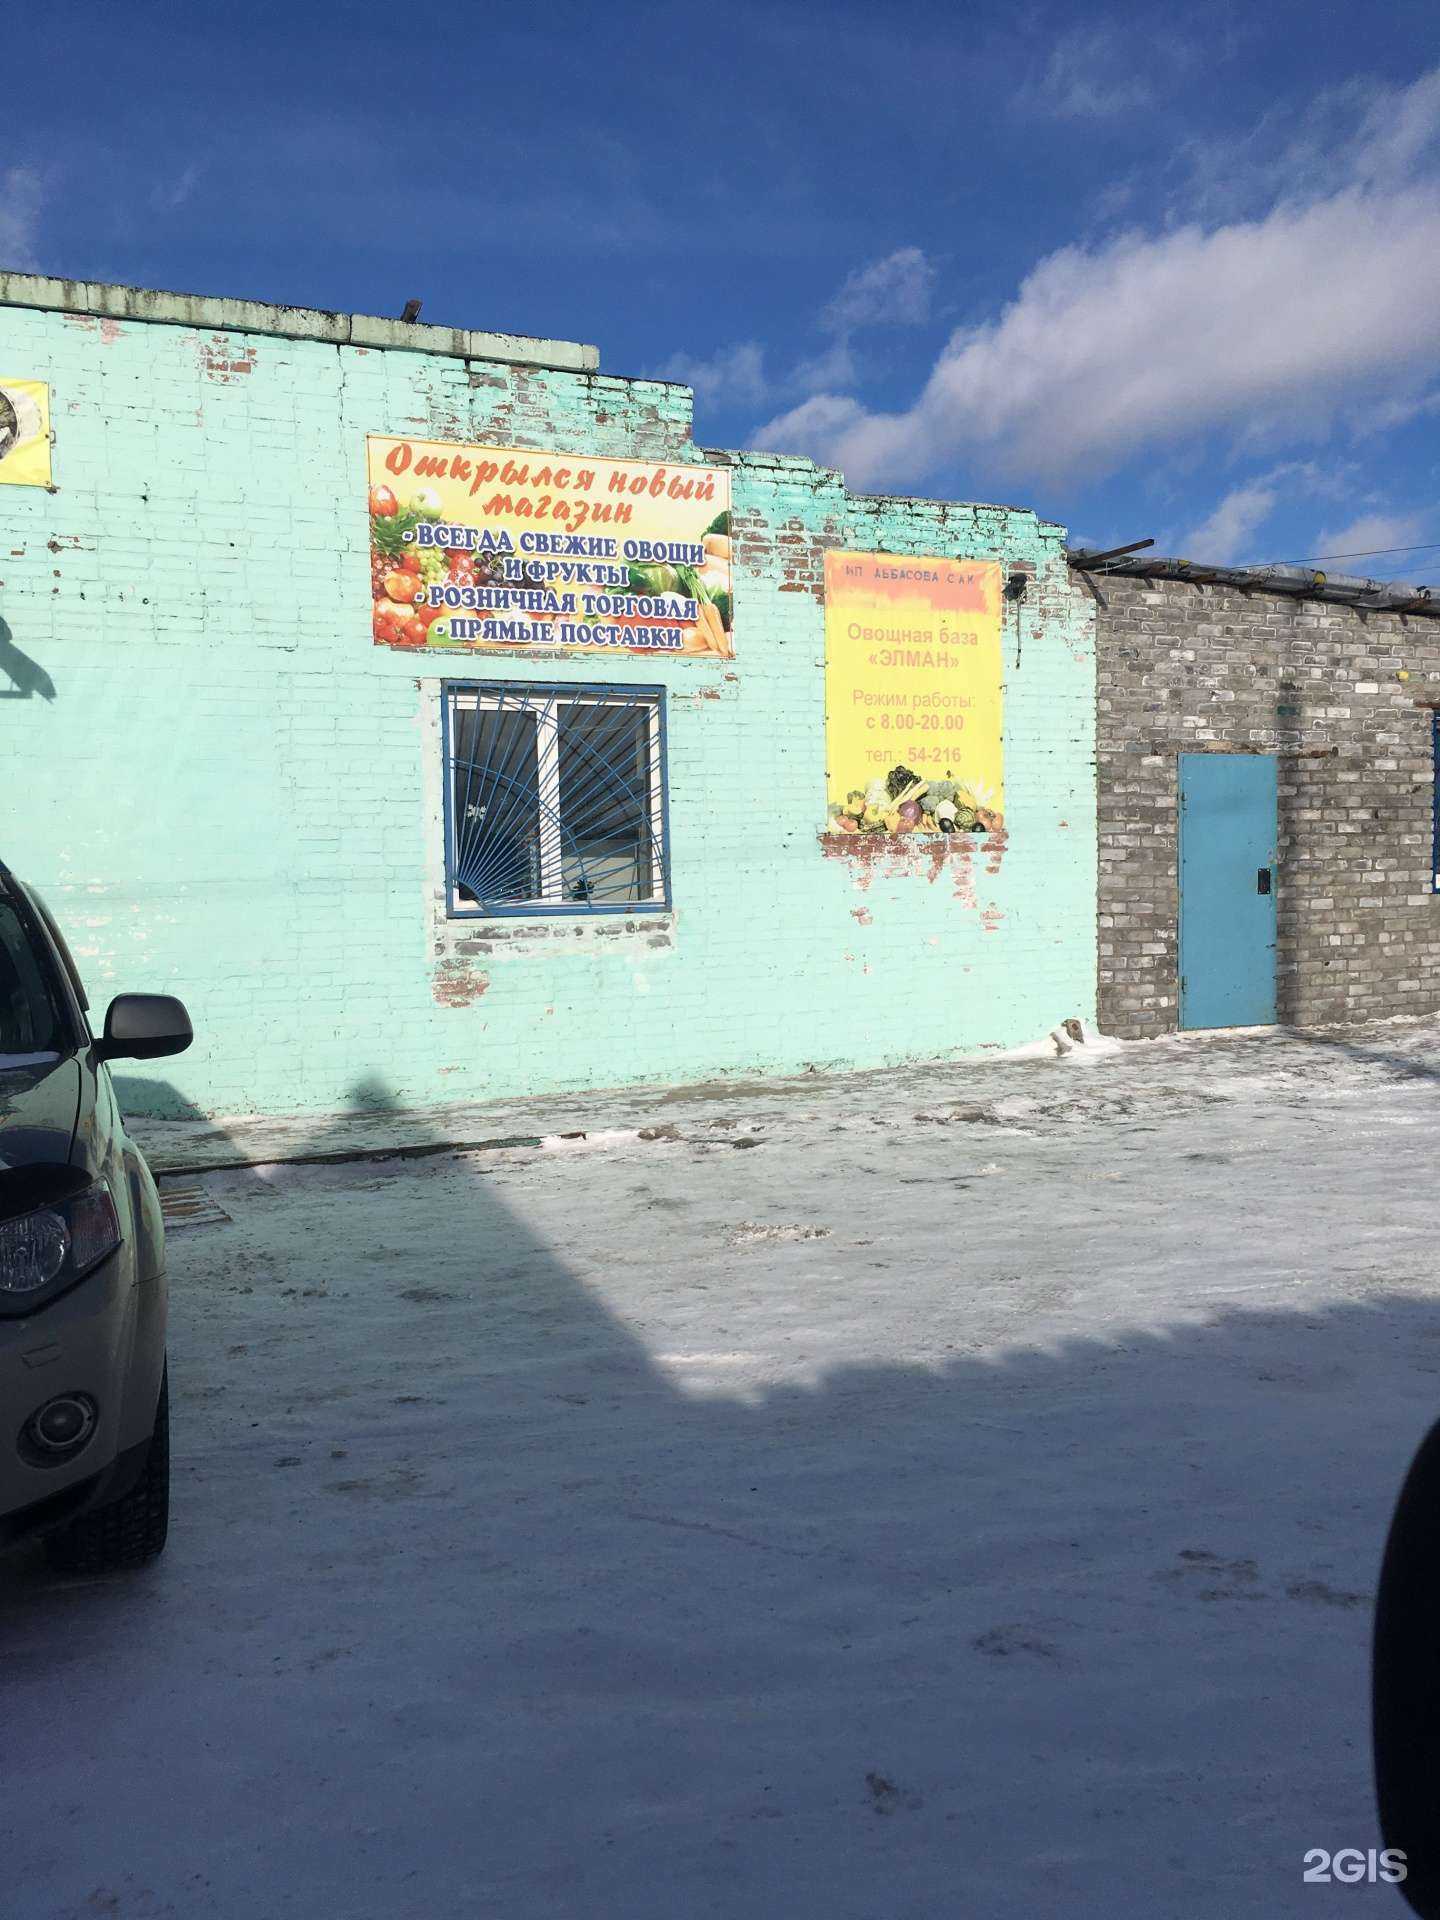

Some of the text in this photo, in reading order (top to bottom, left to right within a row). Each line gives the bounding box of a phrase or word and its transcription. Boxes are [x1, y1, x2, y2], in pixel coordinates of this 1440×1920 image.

[385, 442, 715, 501] Открылся новый
[482, 493, 634, 533] магазин
[418, 525, 513, 551] ВСЕГДА
[520, 532, 617, 558] СВЕЖИЕ
[624, 539, 704, 565] ОВОЩИ
[505, 559, 628, 586] И ФРУКТЫ
[430, 586, 575, 612] РОЗНИЧНАЯ
[582, 594, 698, 619] ТОРГОВЛЯ
[450, 618, 553, 642] ПРЯМЫЕ
[561, 623, 682, 648] ПОСТАВКИ
[847, 622, 978, 646] Овощная база
[868, 648, 960, 669] «ЭЛМАН»
[852, 688, 908, 707] Режим
[880, 713, 965, 731] 8.00-20.00
[907, 746, 962, 763] 54-216
